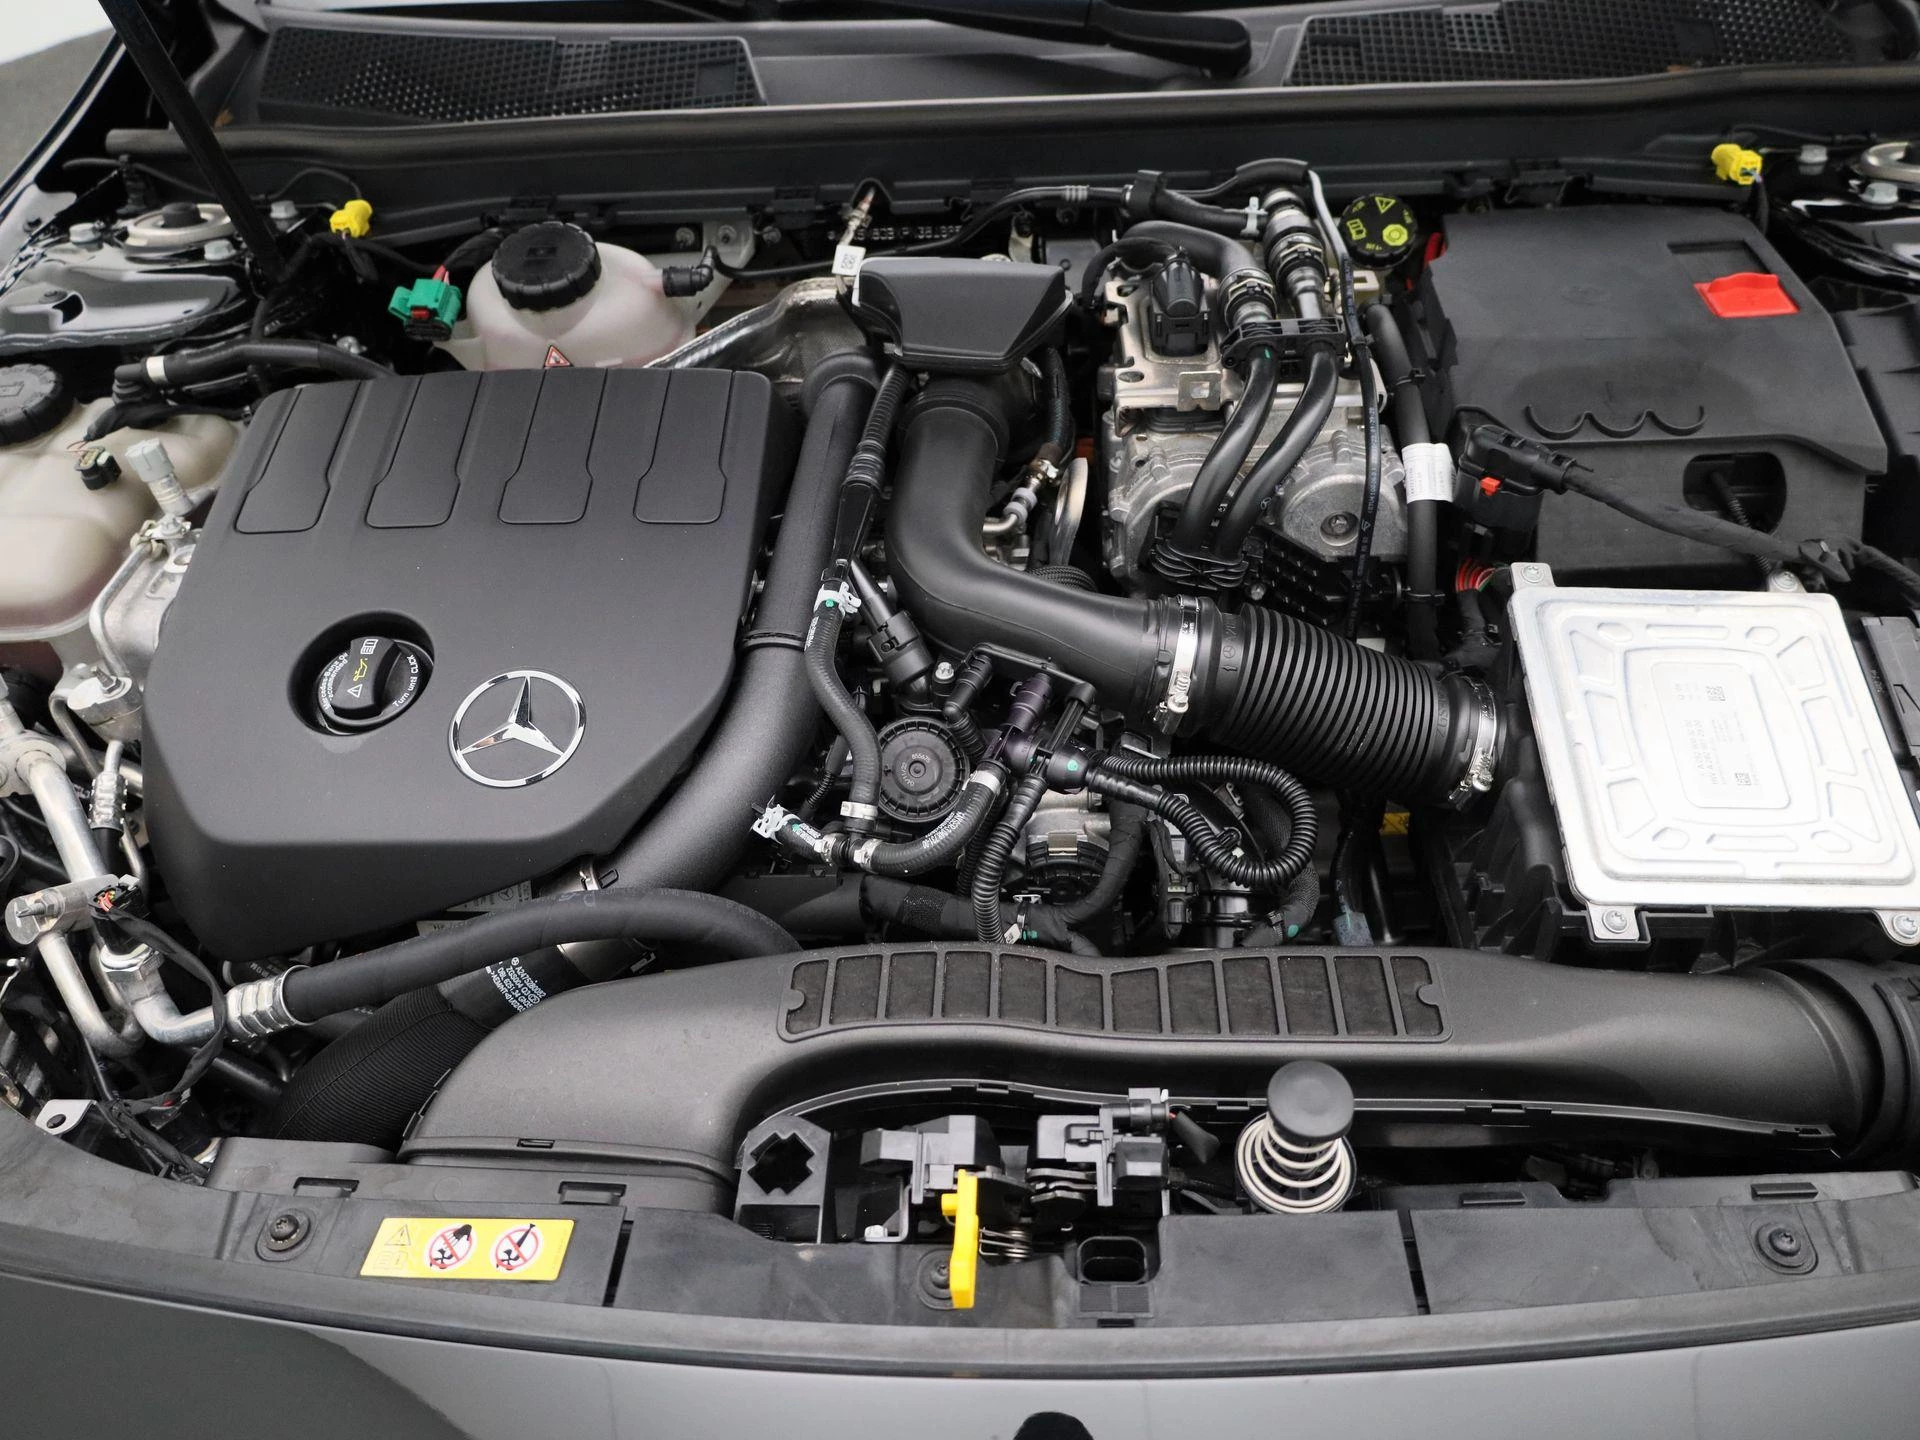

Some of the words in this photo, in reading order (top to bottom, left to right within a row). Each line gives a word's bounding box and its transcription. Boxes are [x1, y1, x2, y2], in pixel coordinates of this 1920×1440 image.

[406, 654, 419, 674] CLICK
[407, 676, 418, 694] until
[392, 691, 410, 708] Turn
